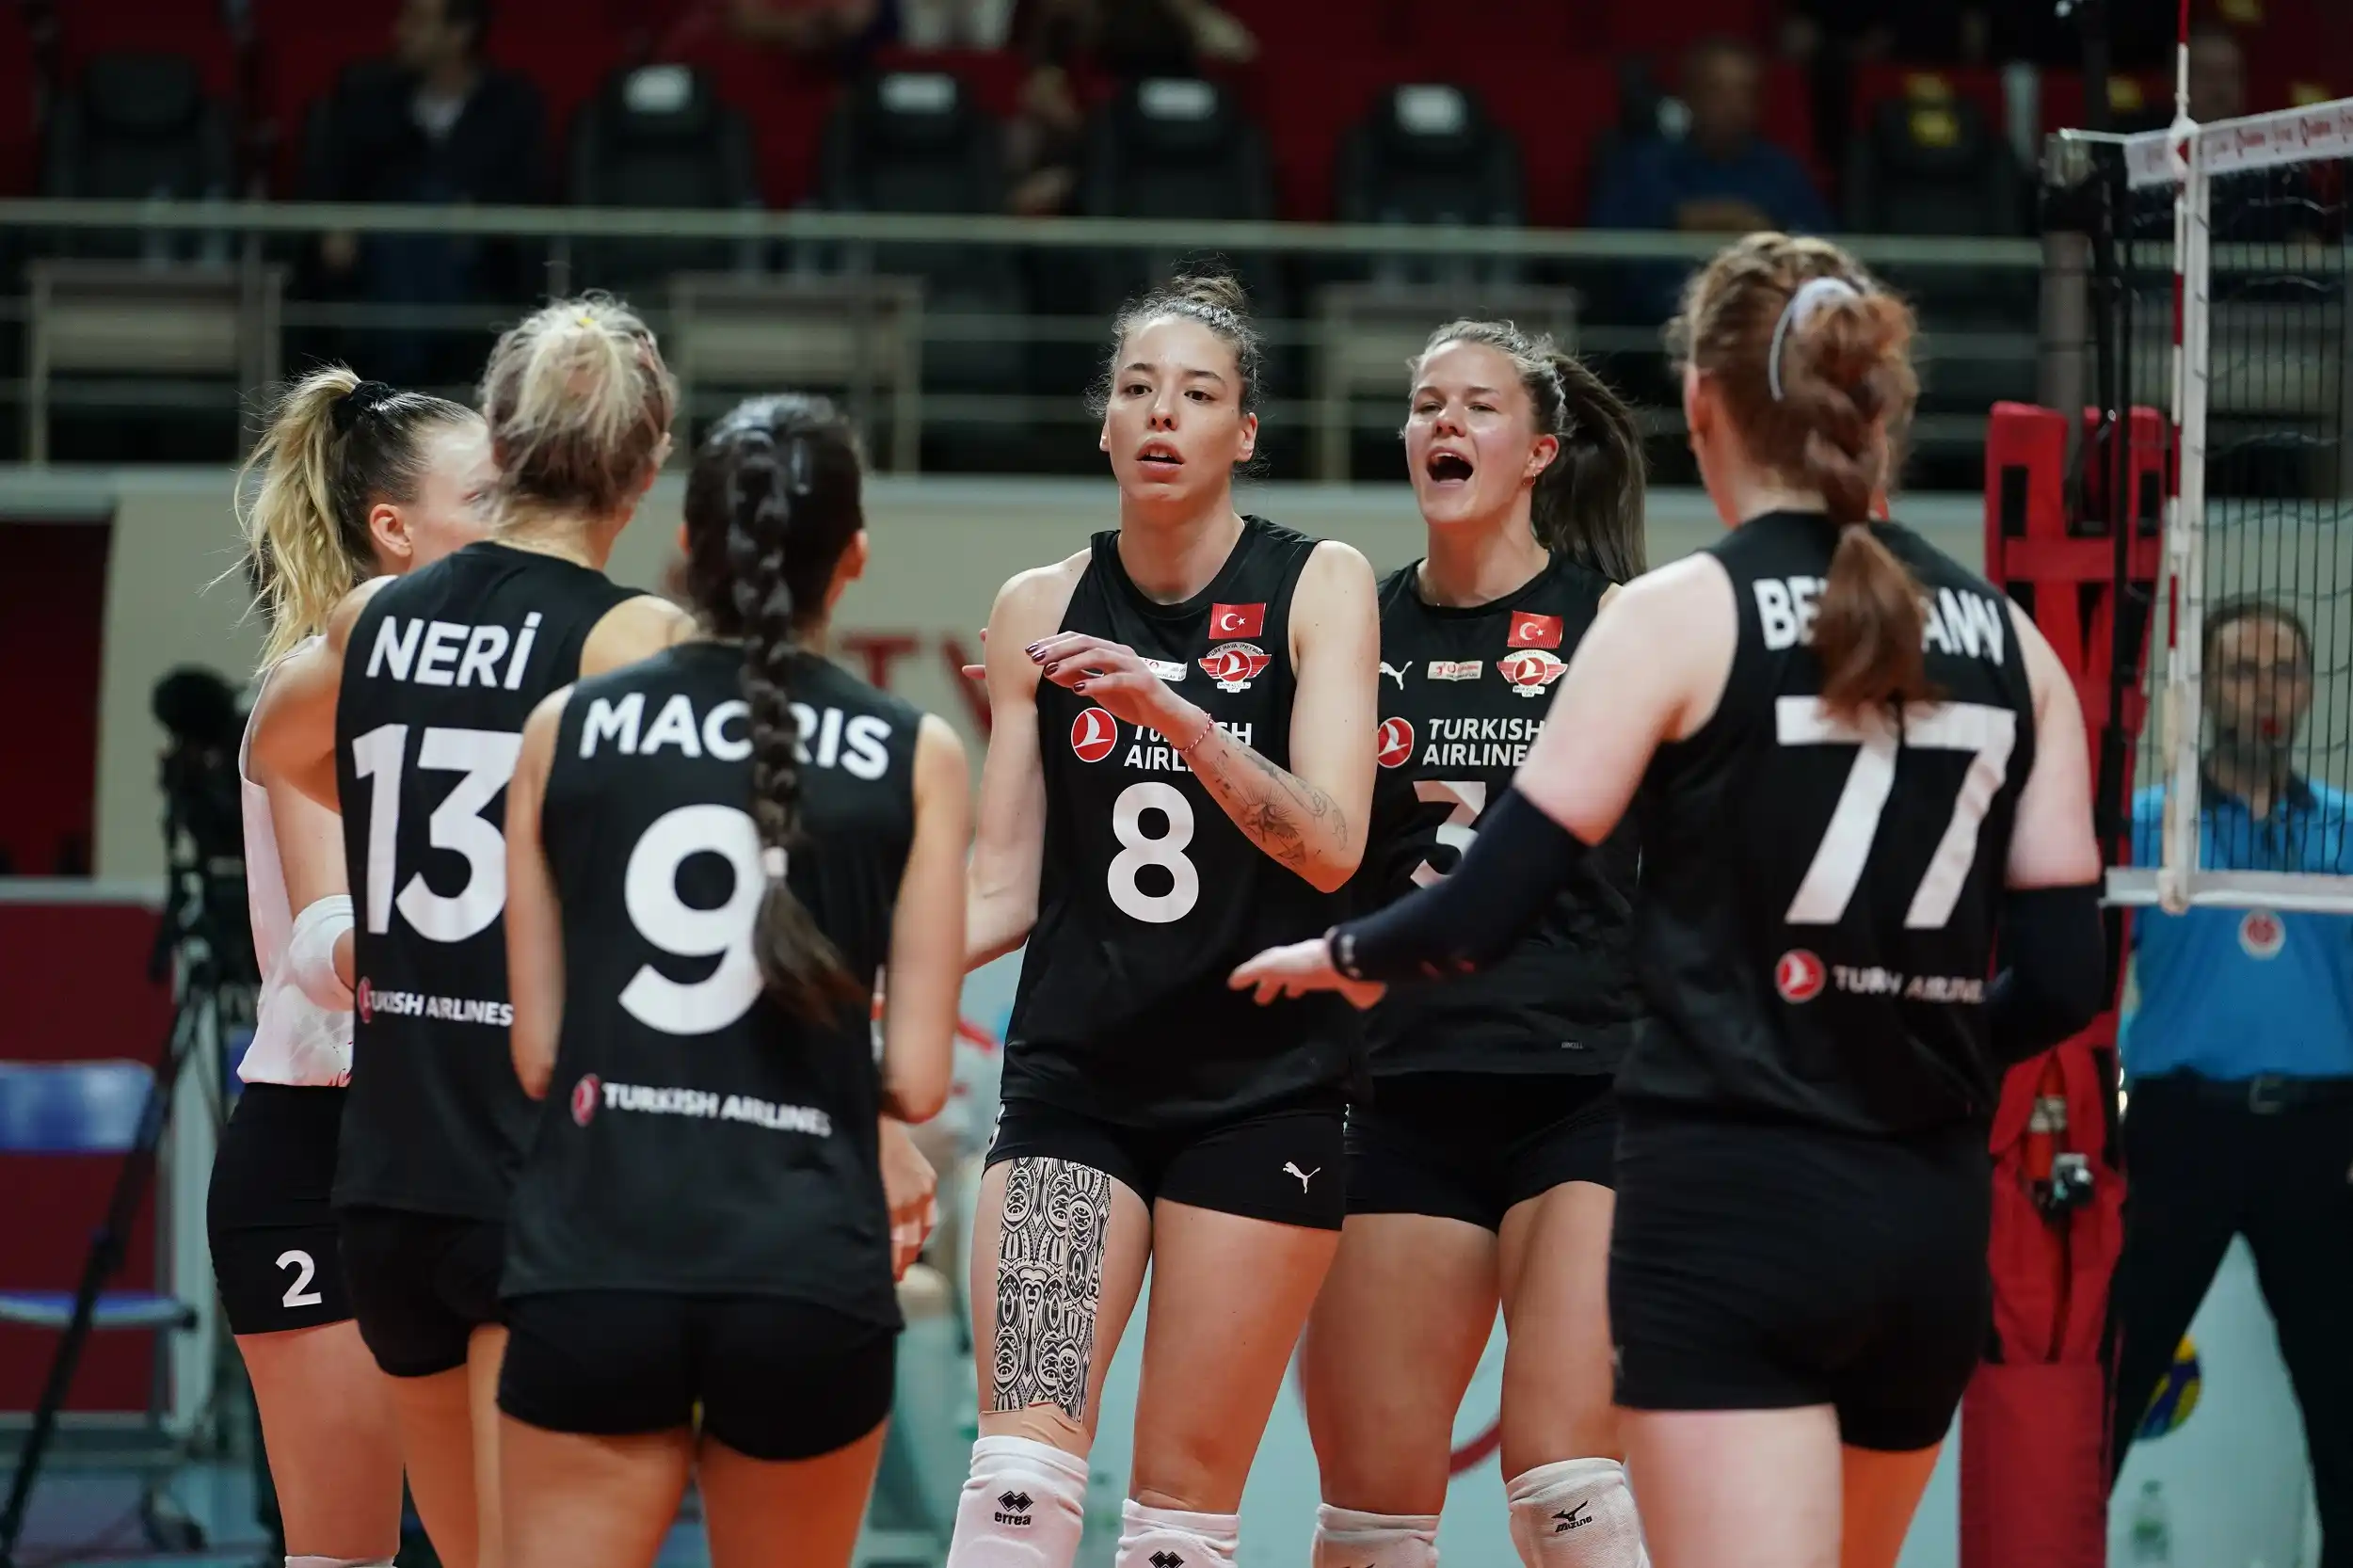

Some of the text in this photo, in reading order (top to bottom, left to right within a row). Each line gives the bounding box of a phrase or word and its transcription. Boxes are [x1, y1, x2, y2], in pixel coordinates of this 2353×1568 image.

[1124, 744, 1194, 773] AIRL
[1422, 743, 1529, 767] AIRLINE
[1429, 718, 1545, 742] TURKISH
[352, 723, 523, 942] 13
[1107, 781, 1200, 923] 8
[1410, 780, 1487, 890] 3
[1775, 695, 2017, 929] 77
[617, 803, 766, 1035] 9
[602, 1081, 719, 1118] TURKISH
[275, 1249, 323, 1308] 2
